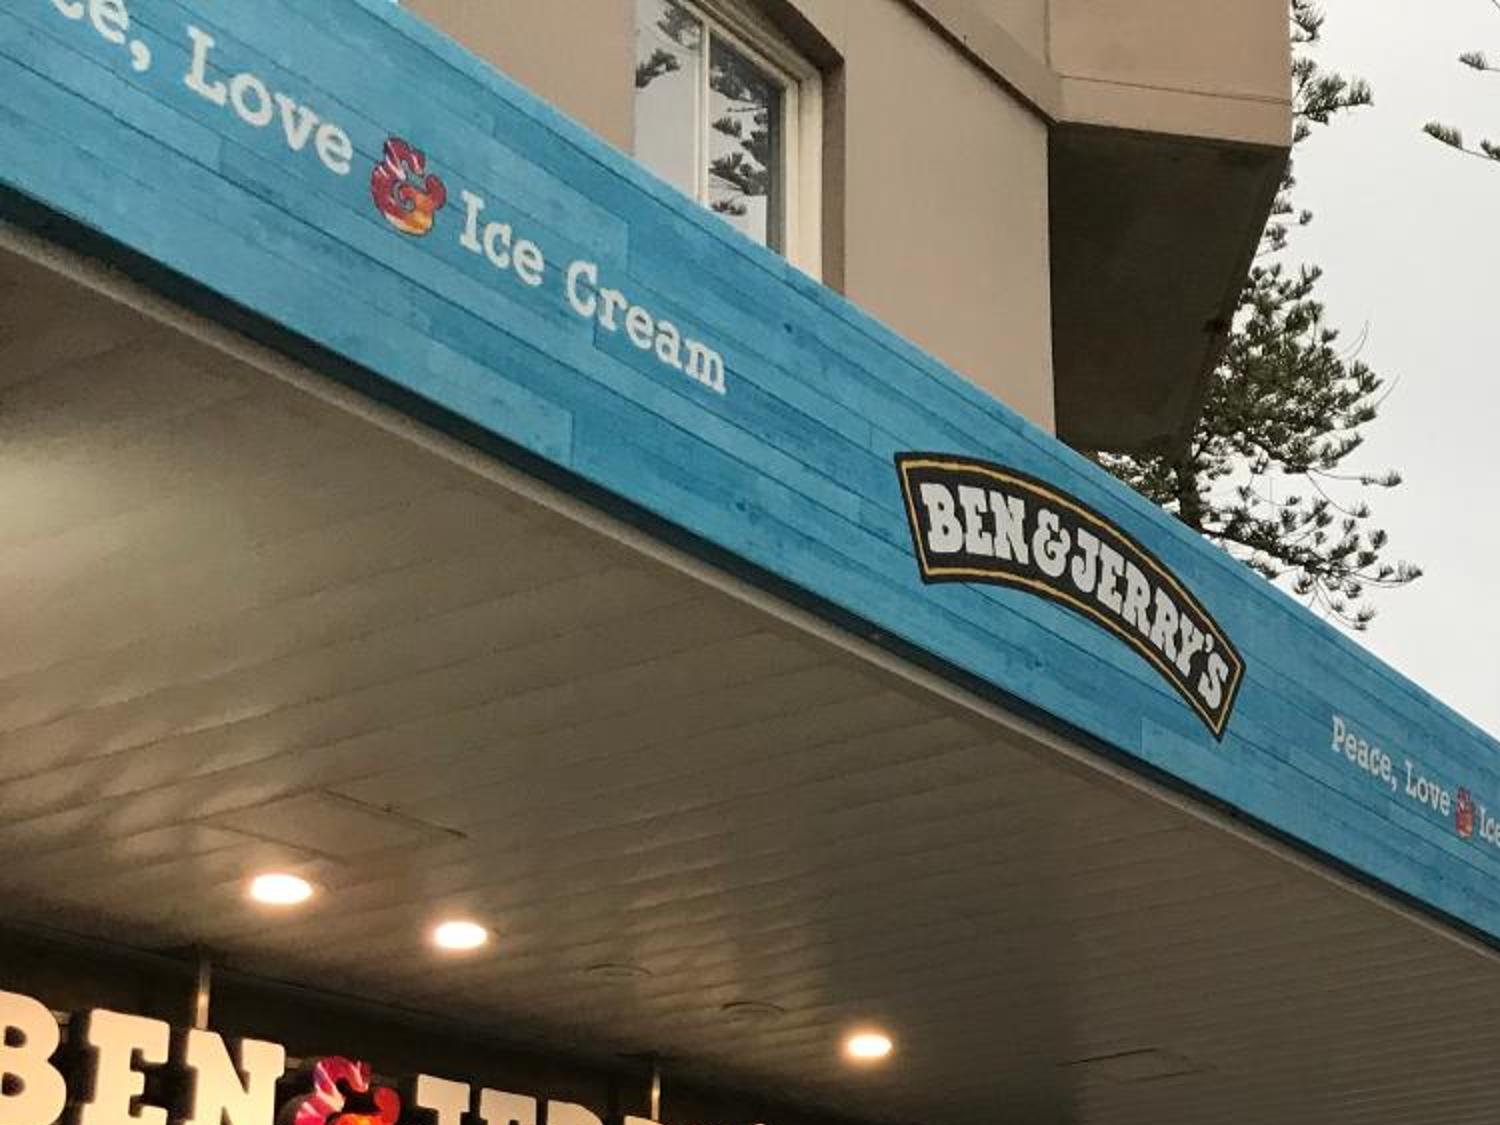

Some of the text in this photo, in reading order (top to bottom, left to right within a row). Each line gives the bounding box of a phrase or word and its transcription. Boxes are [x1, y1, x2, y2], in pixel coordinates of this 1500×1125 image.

[184, 26, 353, 176] Love
[460, 190, 545, 286] Ice
[567, 260, 728, 395] Cream
[1332, 716, 1397, 791] Peace,
[1405, 760, 1451, 817] Love
